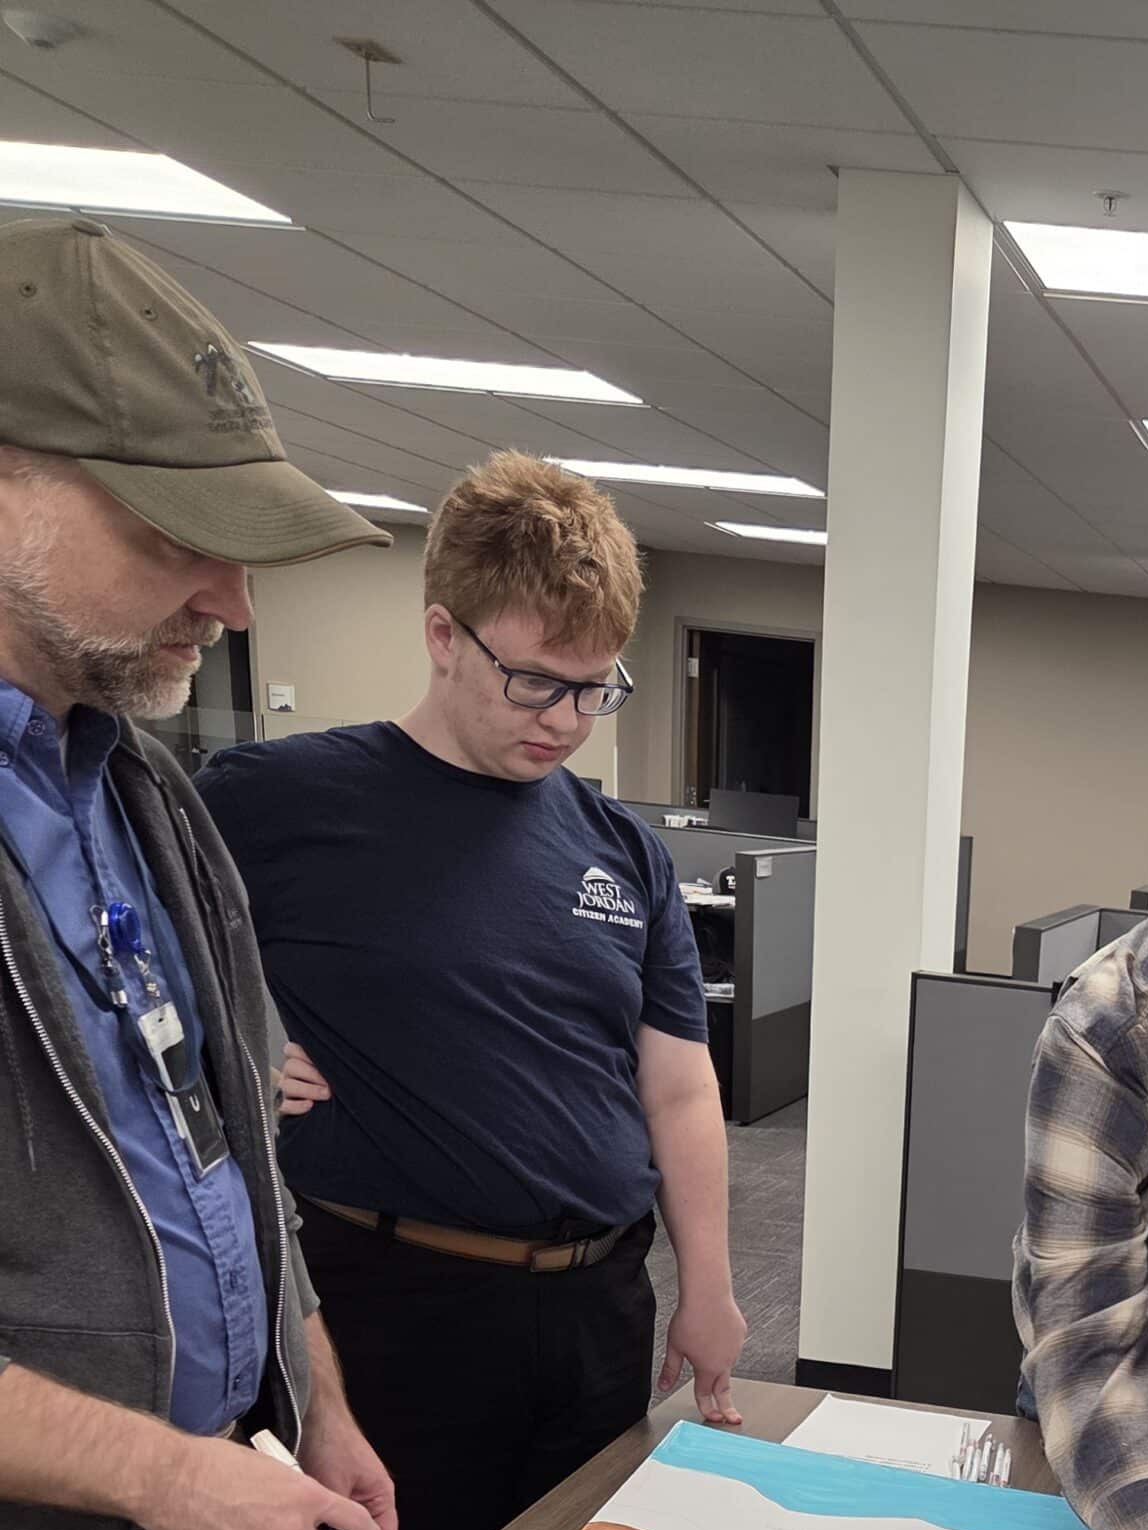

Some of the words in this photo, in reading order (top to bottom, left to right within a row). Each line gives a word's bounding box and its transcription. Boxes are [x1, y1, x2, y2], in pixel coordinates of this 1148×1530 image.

[581, 881, 621, 898] WEST
[577, 891, 635, 914] JORDAN
[572, 908, 606, 921] CITIZEN
[608, 914, 643, 928] ACADEMY
